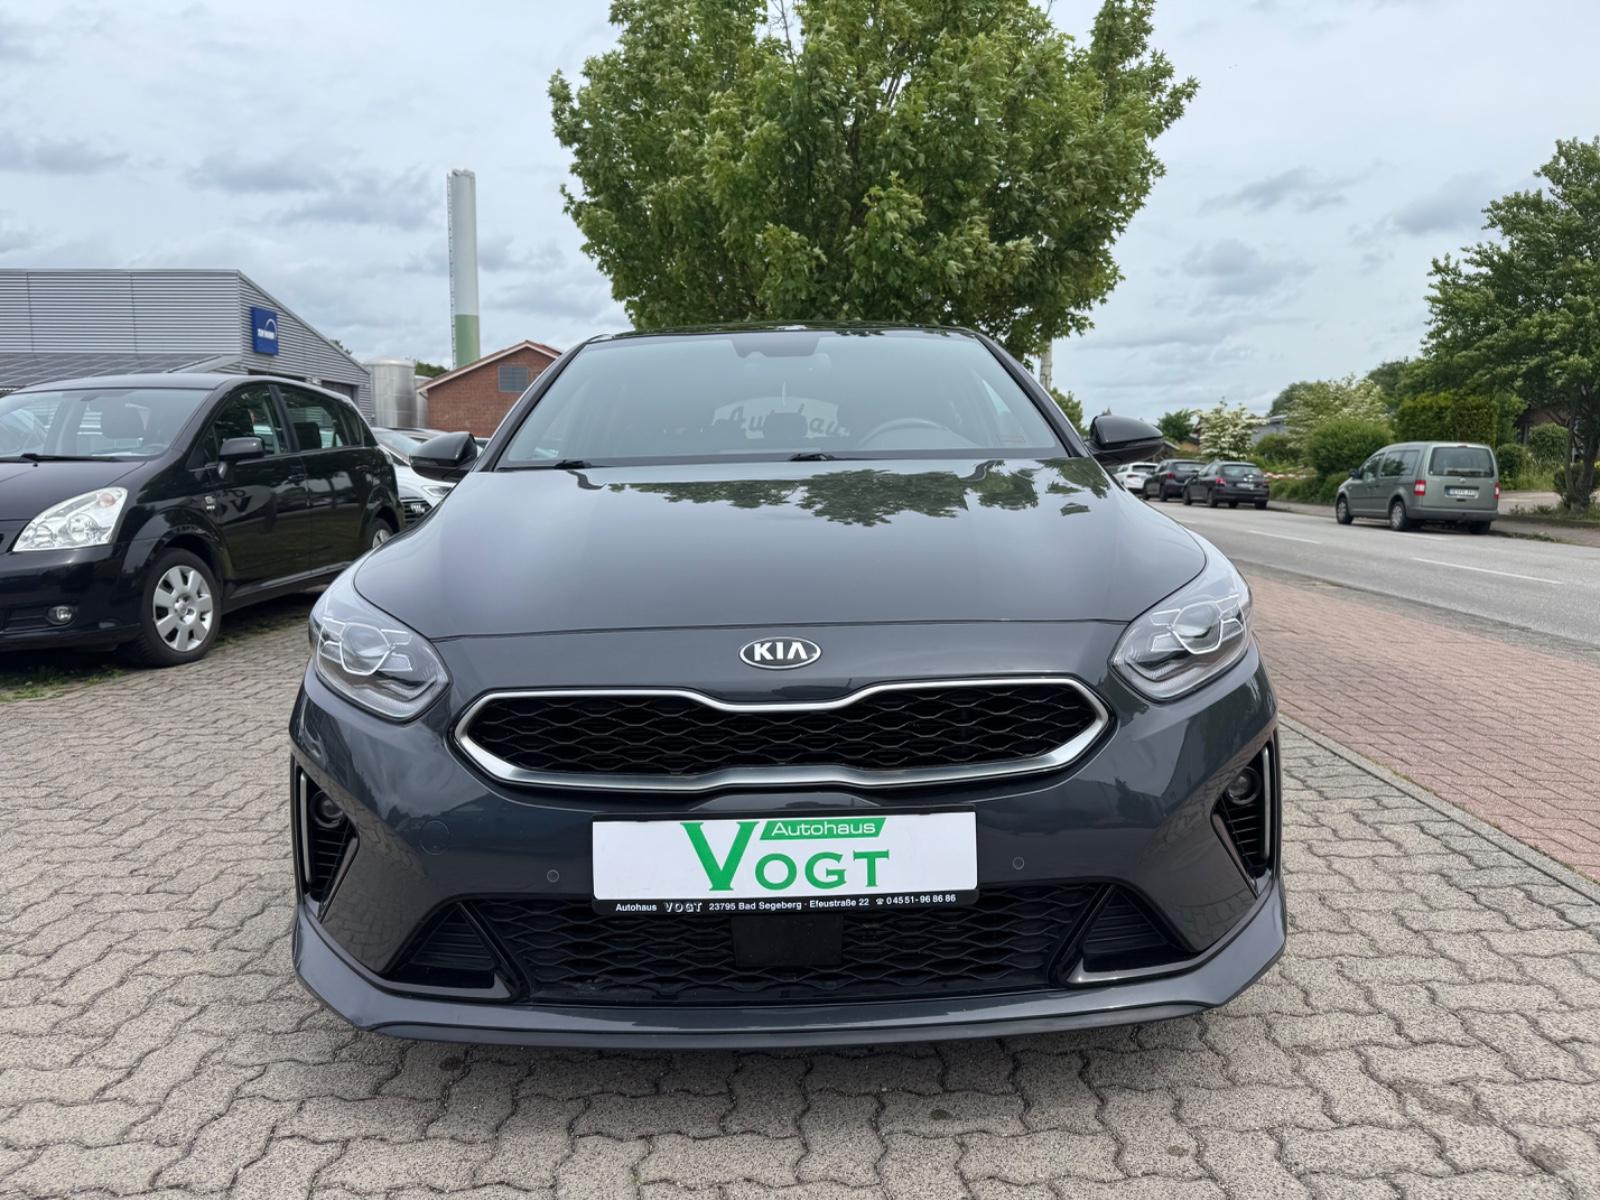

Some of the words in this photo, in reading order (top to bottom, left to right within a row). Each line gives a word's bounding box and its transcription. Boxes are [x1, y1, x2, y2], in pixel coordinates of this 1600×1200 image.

[753, 641, 809, 661] KIA
[771, 820, 877, 837] Autohaus
[679, 821, 890, 892] VOGT
[615, 903, 658, 912] Autohaus
[664, 902, 703, 913] VOGT
[708, 902, 736, 911] 23795
[738, 901, 756, 911] Bad
[758, 900, 802, 912] Segeberg
[809, 898, 857, 909] Efeustraße
[858, 898, 870, 906] 22
[932, 894, 944, 903] 86
